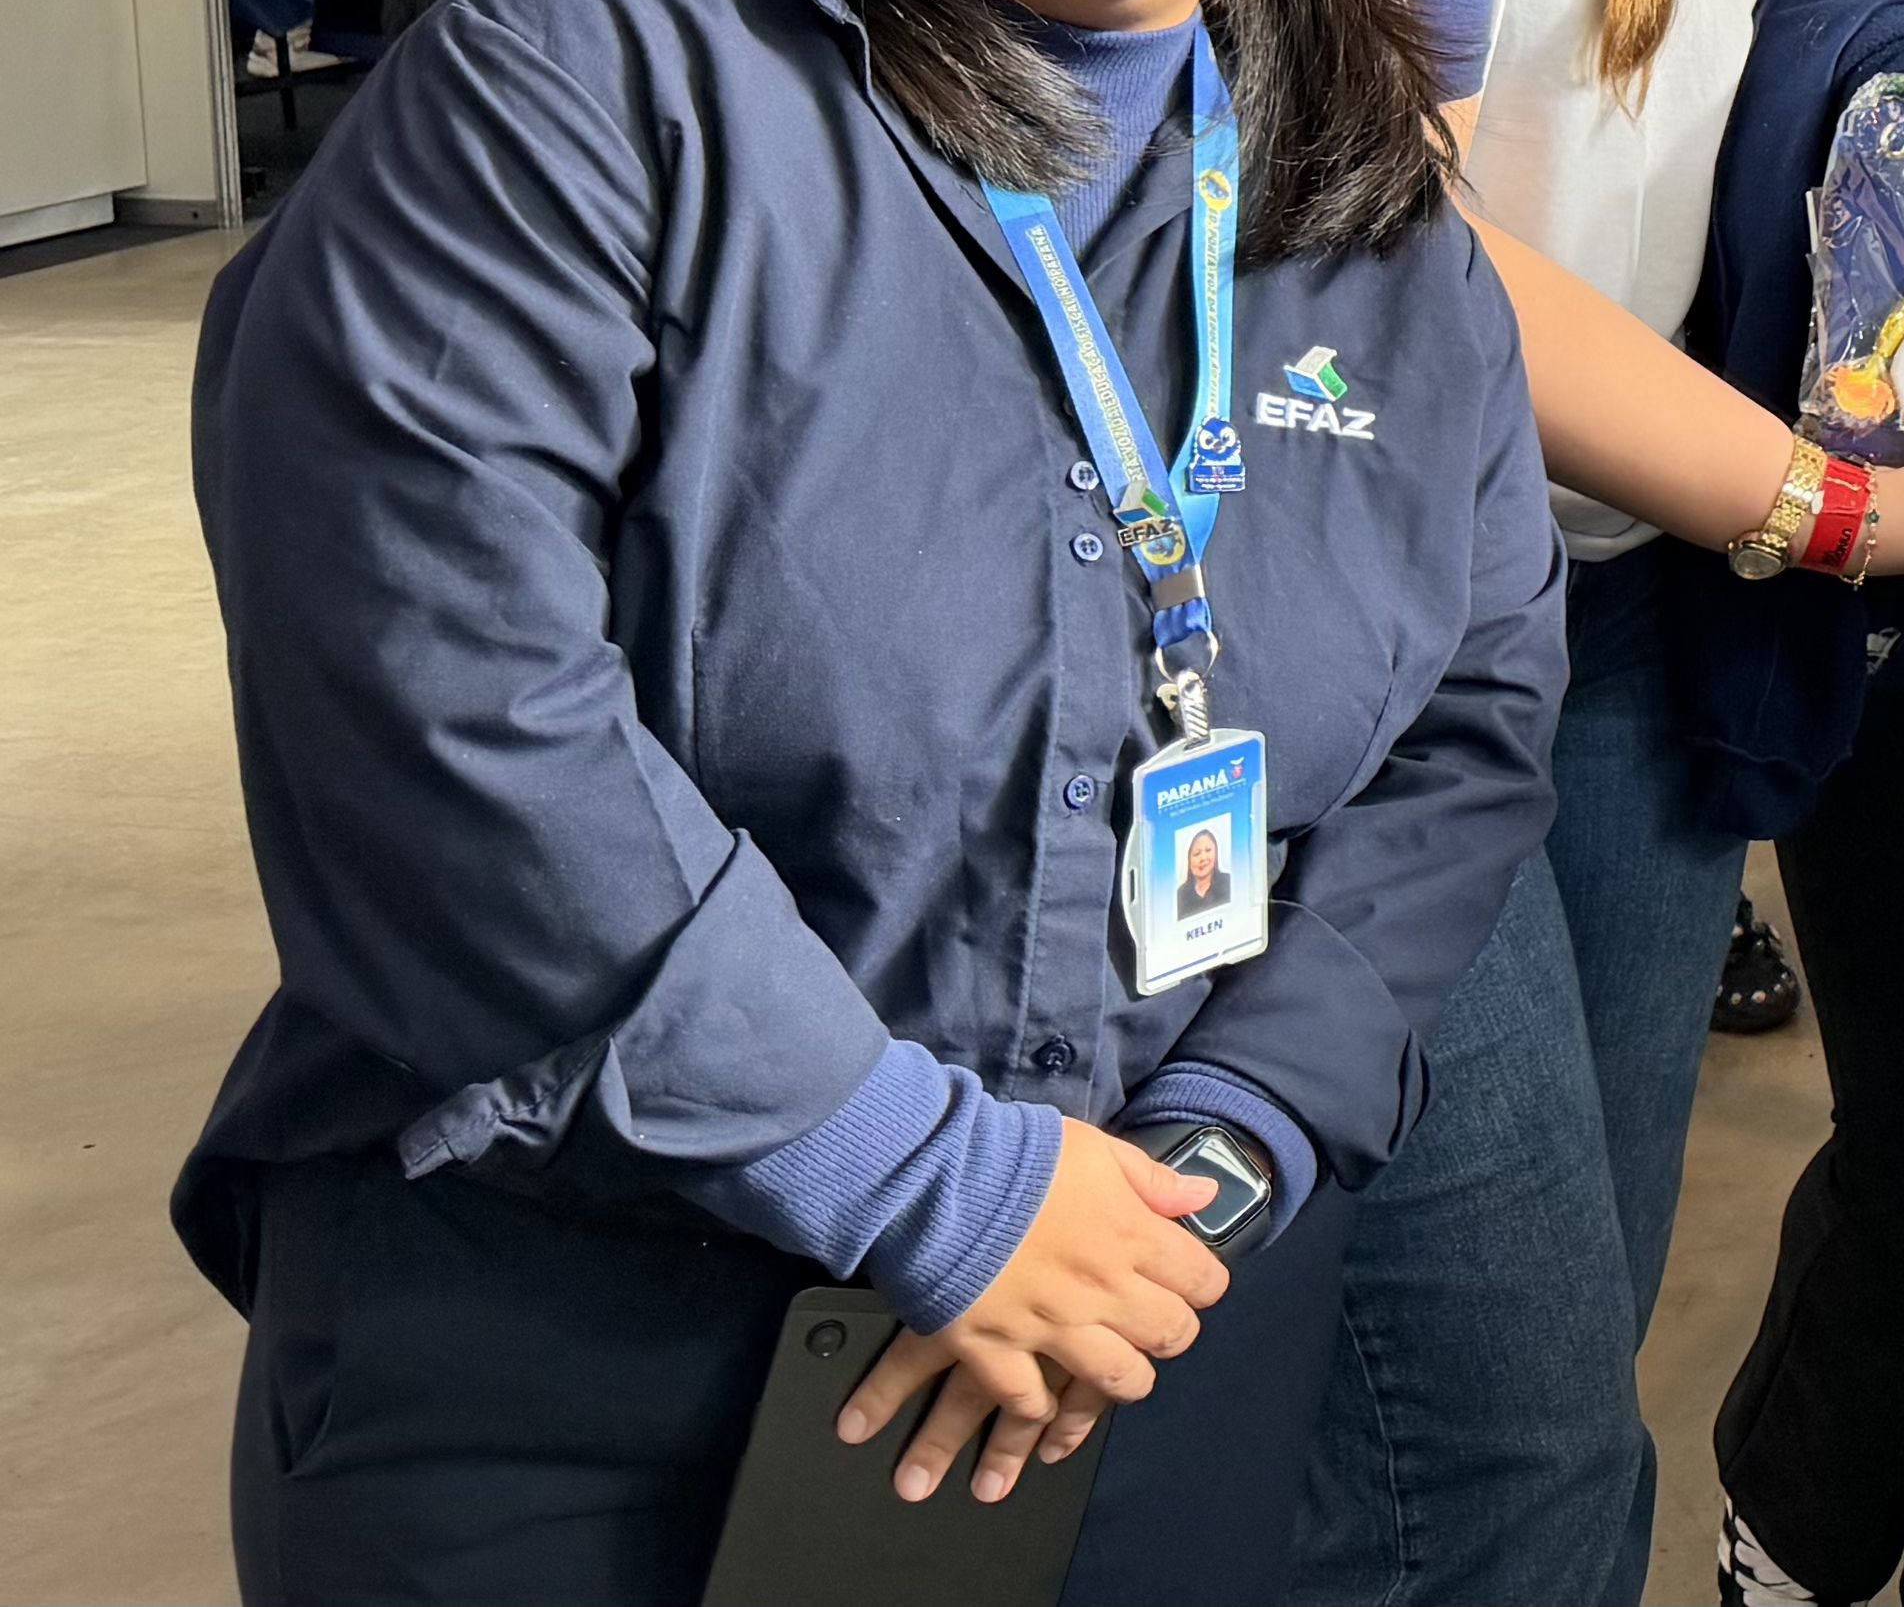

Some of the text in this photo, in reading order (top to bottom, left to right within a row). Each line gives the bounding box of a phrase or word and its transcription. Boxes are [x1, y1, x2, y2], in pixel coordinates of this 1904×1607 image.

[1257, 392, 1376, 441] EFAZ
[1118, 518, 1176, 547] EFAZ
[1156, 768, 1230, 808] PARANÁ
[1185, 919, 1224, 942] KELEN
